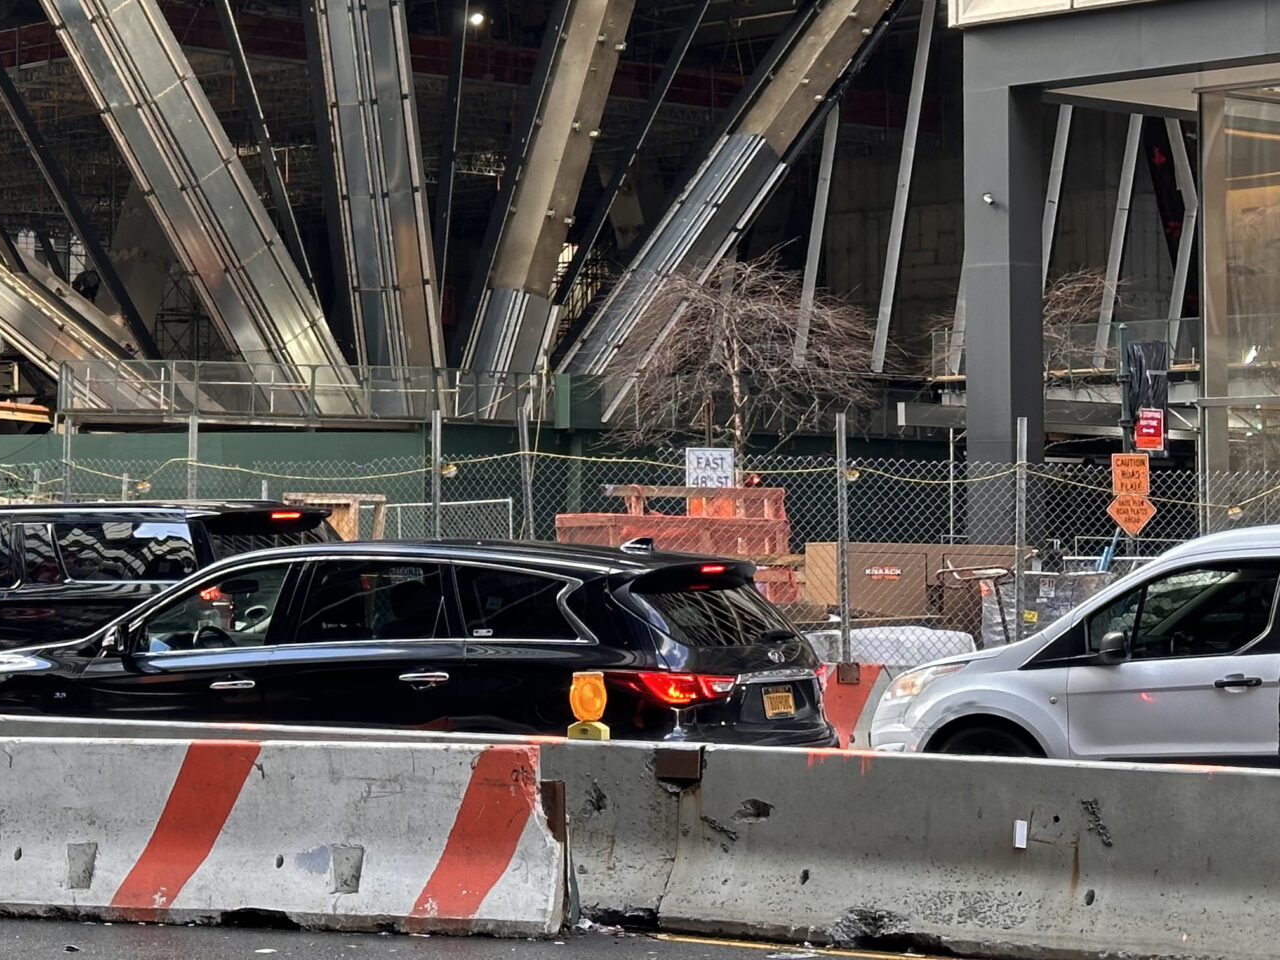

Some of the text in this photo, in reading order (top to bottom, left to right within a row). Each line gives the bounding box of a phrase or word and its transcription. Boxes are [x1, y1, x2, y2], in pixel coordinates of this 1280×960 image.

[696, 457, 726, 470] EAST
[1116, 459, 1146, 468] CAUTION
[1121, 470, 1141, 479] ROAD
[716, 475, 730, 488] ST
[1120, 482, 1142, 491] PLATE
